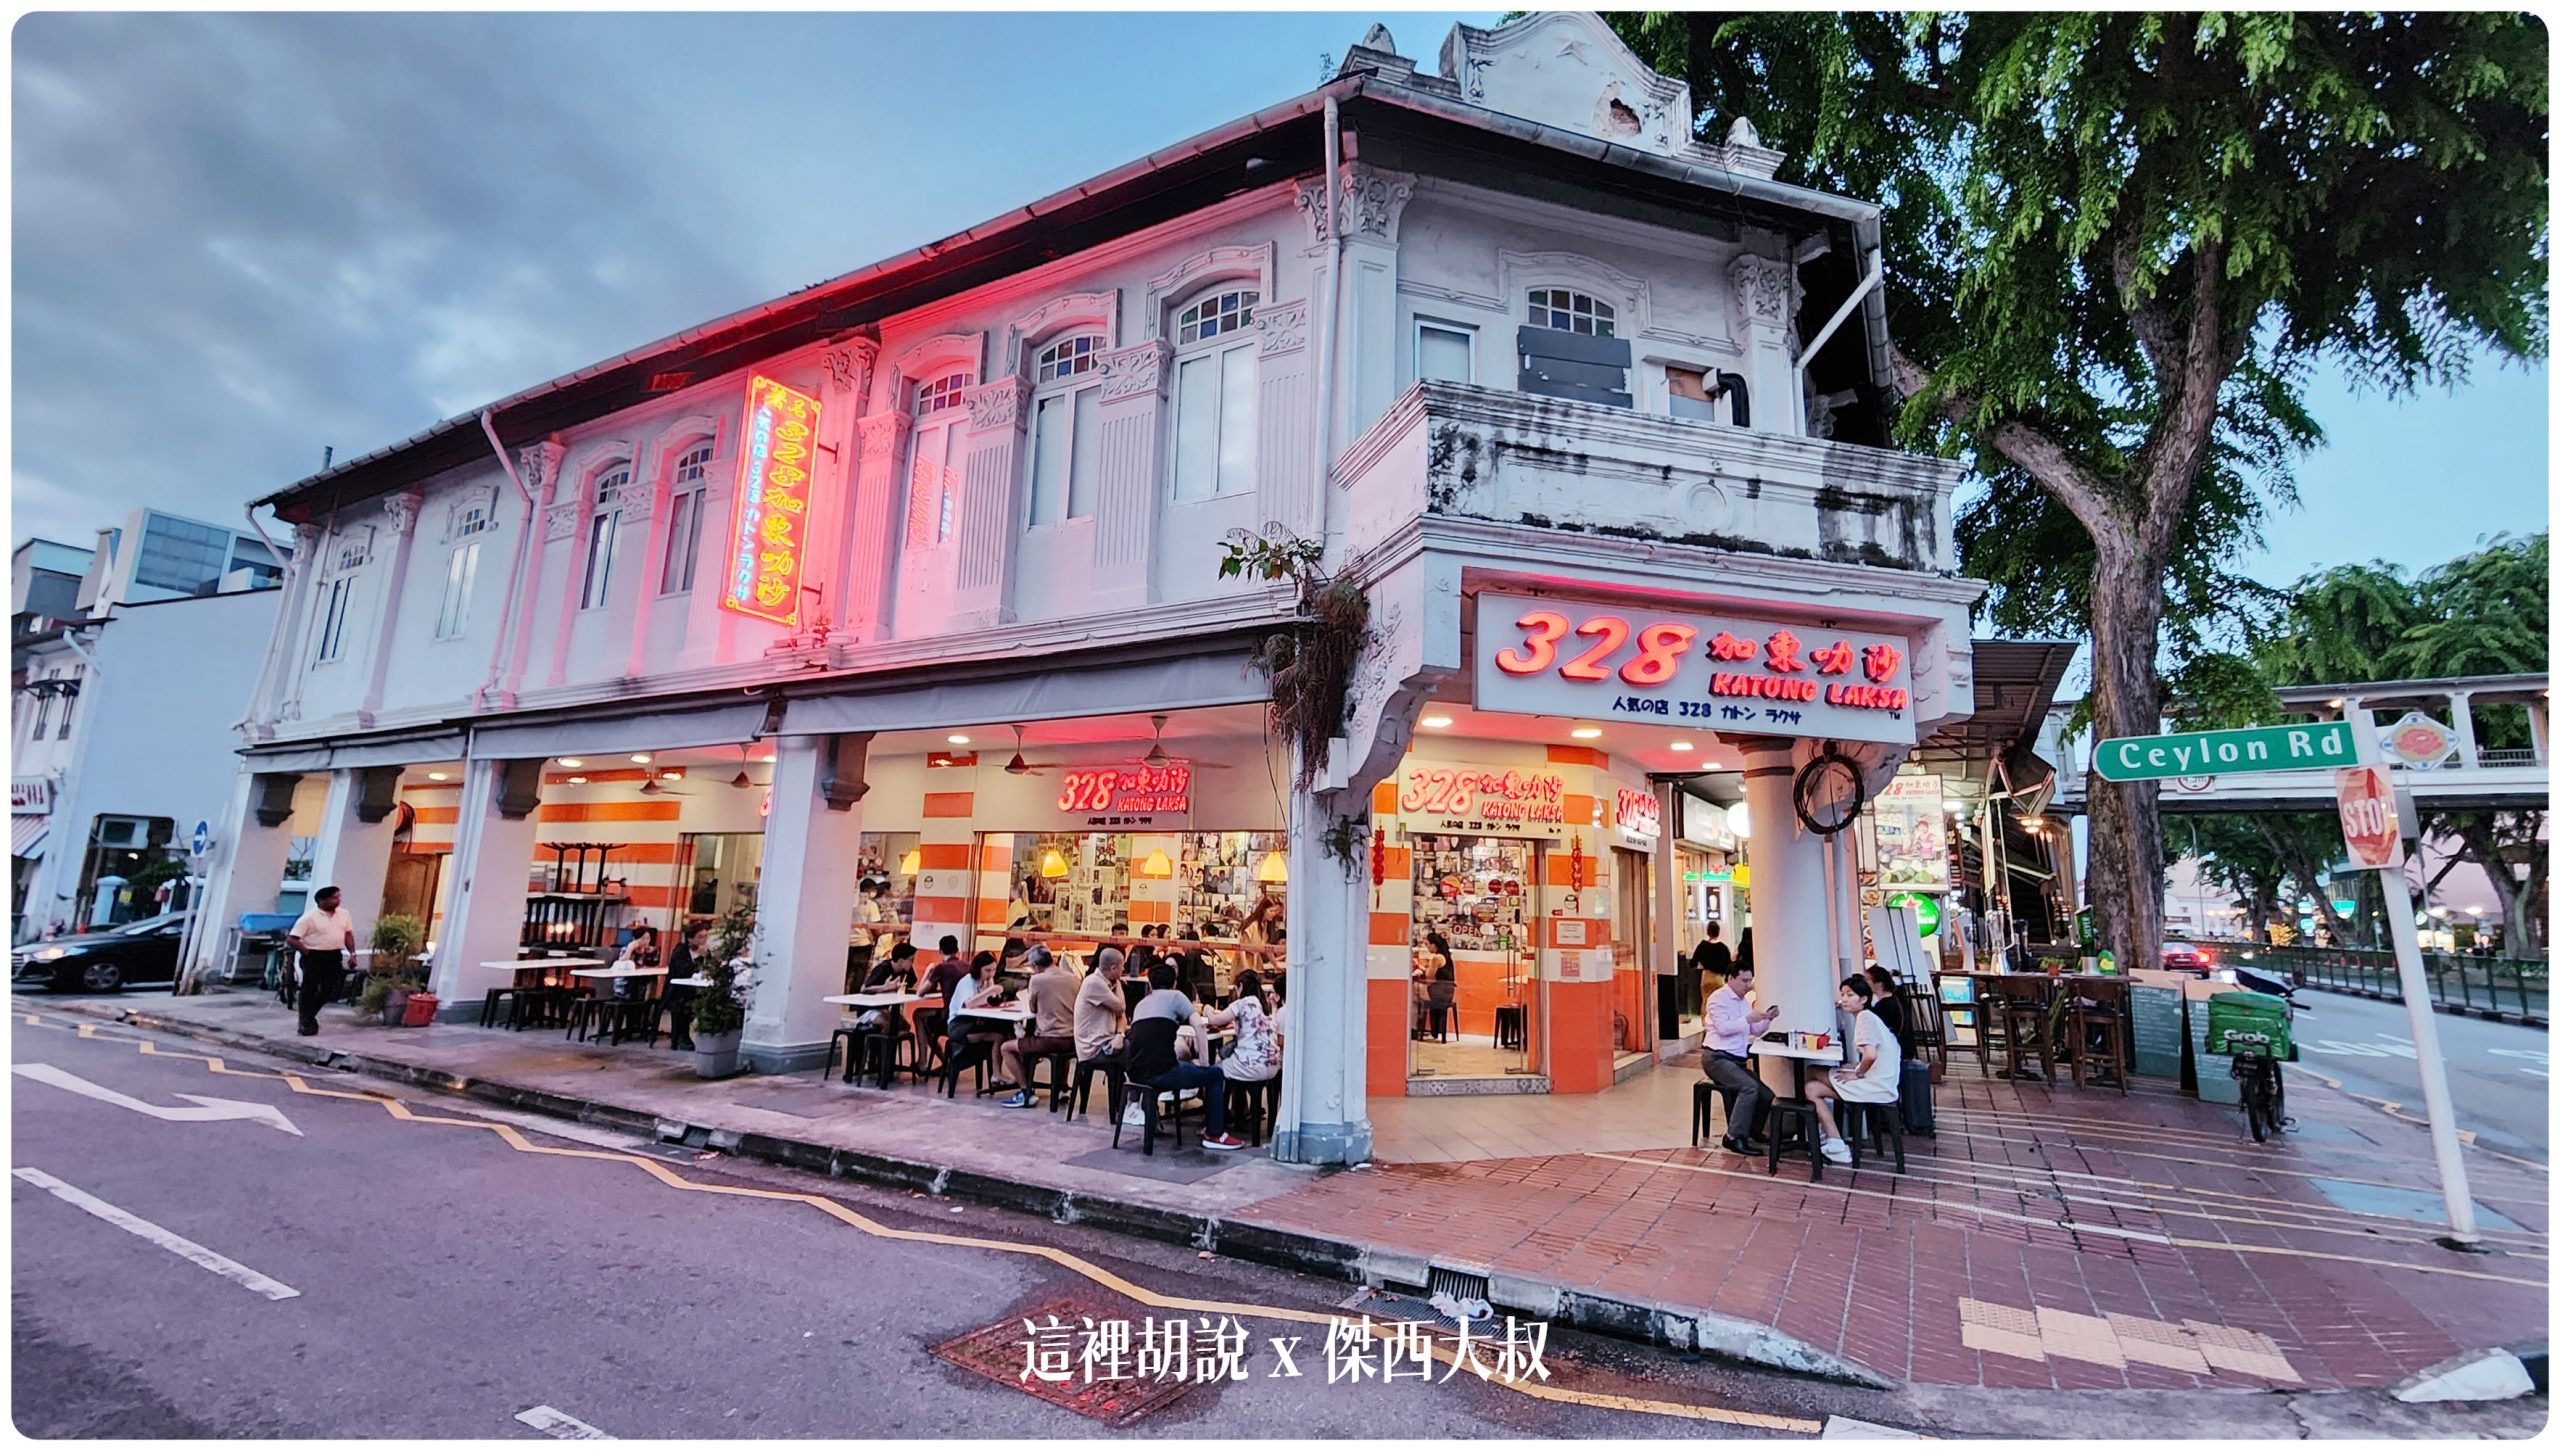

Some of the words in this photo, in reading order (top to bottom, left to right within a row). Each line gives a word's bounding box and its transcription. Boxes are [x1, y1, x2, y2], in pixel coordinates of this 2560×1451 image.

[1495, 611, 1699, 688] 328
[1705, 628, 1904, 684] 加東叻沙
[1708, 671, 1820, 703] KATONG
[1823, 681, 1910, 711] LAKSA
[1612, 696, 1669, 715] 人気の店
[1679, 701, 1712, 717] 328
[1720, 704, 1757, 720] カトン
[1765, 709, 1802, 725] ラクサ
[2118, 737, 2268, 772] Ceylon
[2287, 727, 2344, 758] Rd
[1057, 769, 1119, 813] 328
[1116, 796, 1154, 813] KATONG
[1155, 795, 1189, 813] LAKSA
[1401, 768, 1480, 815] 328
[1480, 800, 1527, 821] KATONG
[1527, 804, 1564, 824] LAKSA
[1452, 924, 1482, 937] OPEN
[2223, 1028, 2271, 1044] Grab
